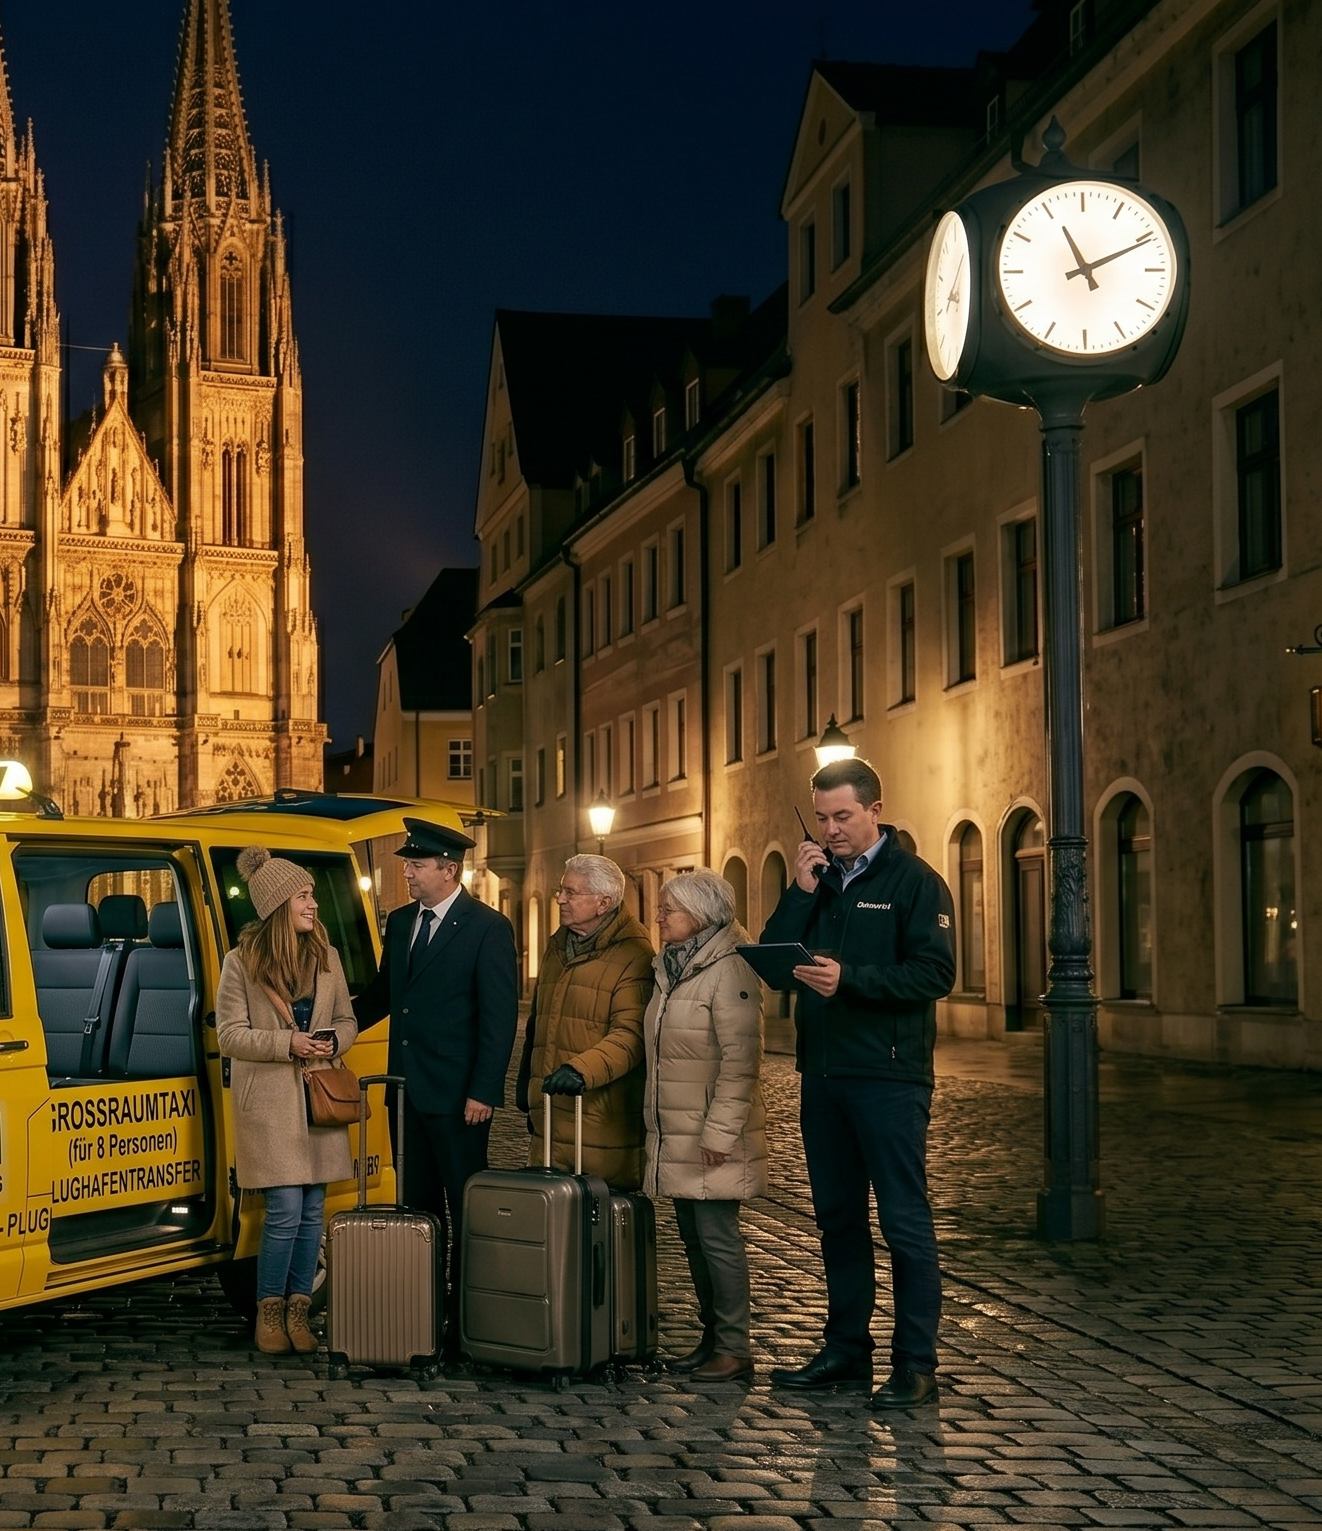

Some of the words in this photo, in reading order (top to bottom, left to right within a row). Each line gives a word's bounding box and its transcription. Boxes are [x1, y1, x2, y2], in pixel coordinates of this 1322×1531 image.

[68, 1137, 94, 1169] (für
[97, 1136, 105, 1159] 8
[109, 1126, 178, 1158] Personen)
